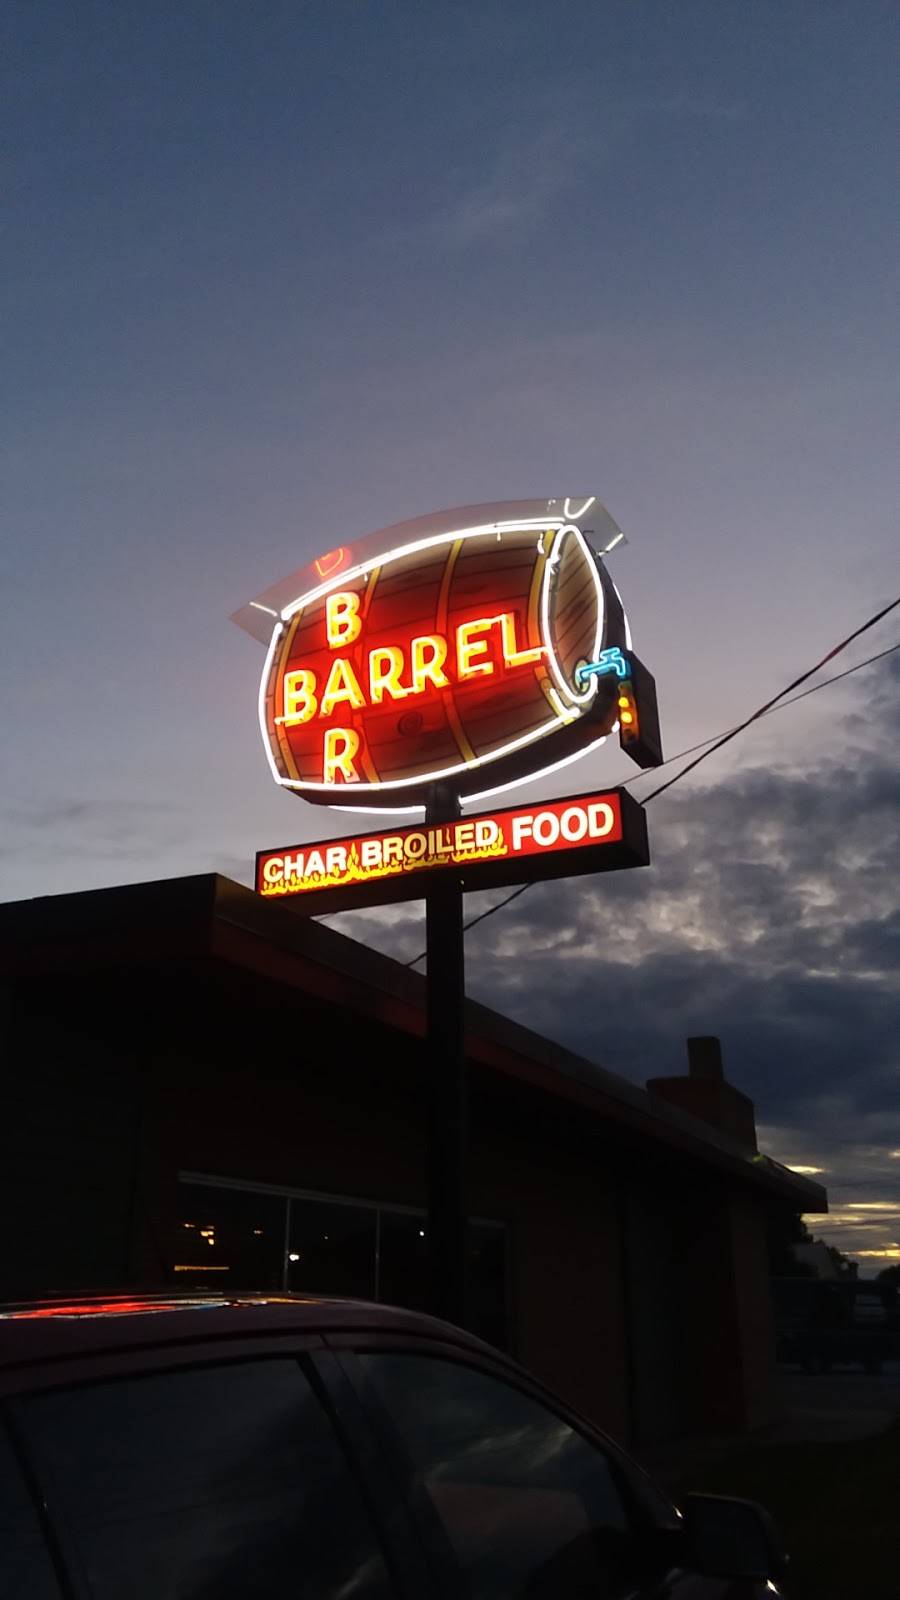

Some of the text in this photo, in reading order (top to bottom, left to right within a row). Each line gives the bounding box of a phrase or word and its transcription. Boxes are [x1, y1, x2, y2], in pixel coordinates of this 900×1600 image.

[281, 612, 543, 727] BARREL
[262, 802, 615, 883] CHAR BROILED FOOD
